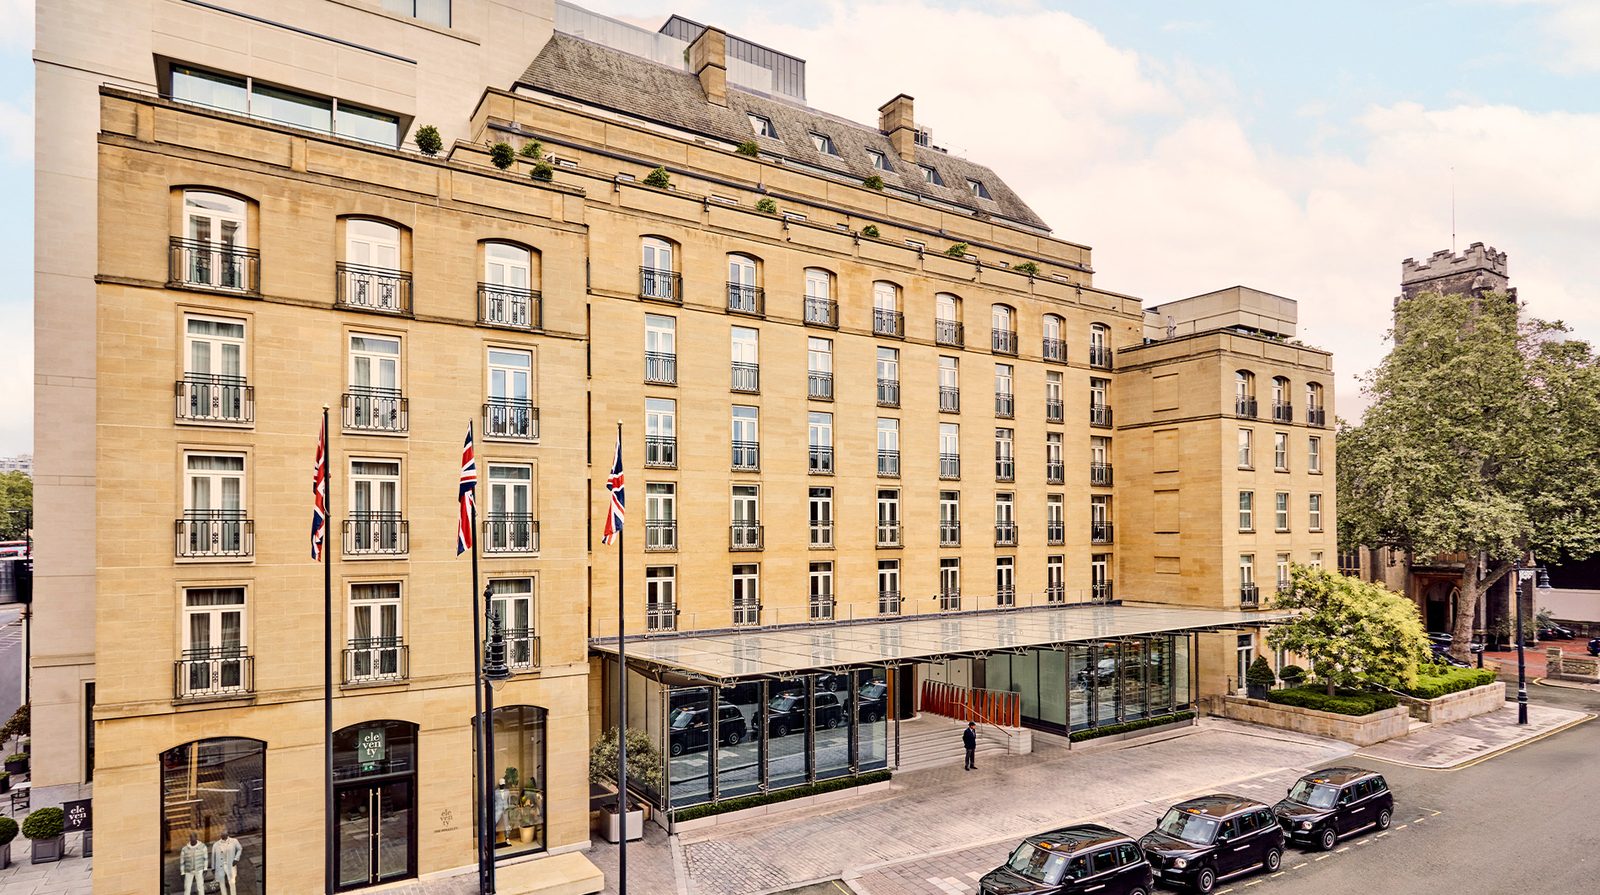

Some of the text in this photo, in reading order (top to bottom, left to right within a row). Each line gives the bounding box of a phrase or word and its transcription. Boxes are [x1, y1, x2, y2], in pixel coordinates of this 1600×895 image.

[364, 731, 380, 742] ele
[362, 741, 381, 749] ven
[367, 748, 377, 758] ty
[70, 805, 85, 814] ele
[69, 812, 87, 820] ven
[72, 819, 83, 827] ty
